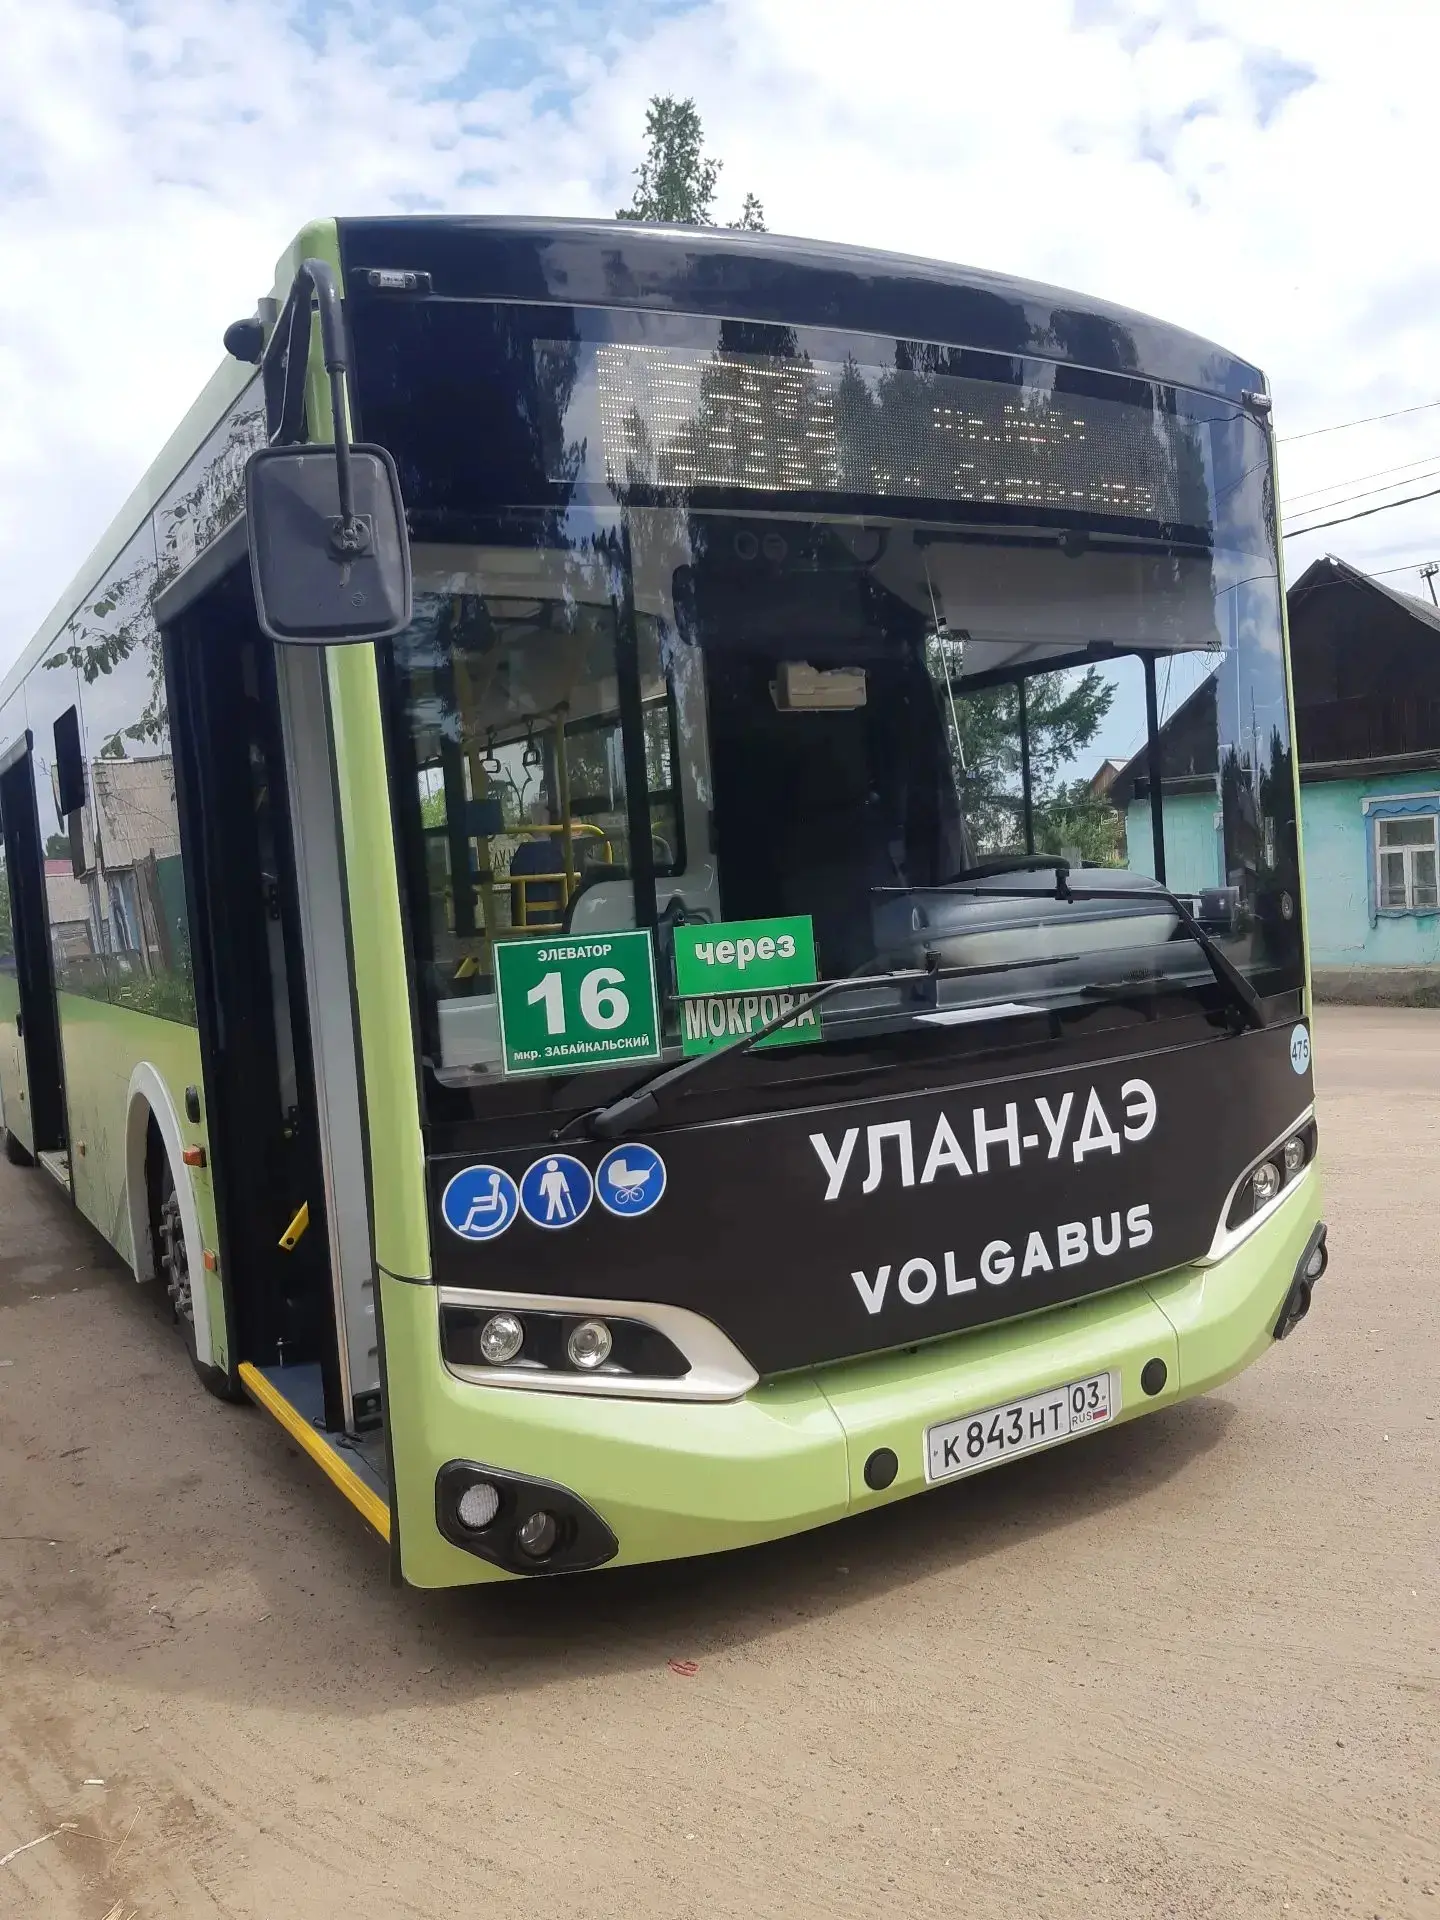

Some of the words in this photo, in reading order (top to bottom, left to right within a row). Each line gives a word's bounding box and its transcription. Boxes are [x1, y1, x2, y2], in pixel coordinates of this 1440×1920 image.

[537, 944, 612, 962] ЭЛЕВАТОР
[695, 934, 796, 970] через
[527, 967, 630, 1035] 16
[514, 1049, 542, 1061] мкр.
[544, 1034, 650, 1057] ЗАБАЙКАЛЬСКИЙ
[1292, 1039, 1309, 1060] 475
[808, 1078, 1157, 1201] УЛАН-УДЭ
[851, 1203, 1154, 1314] VOLGABUS
[943, 1402, 1063, 1468] К843НТ
[1072, 1381, 1100, 1413] 03
[1072, 1411, 1092, 1426] RUS
